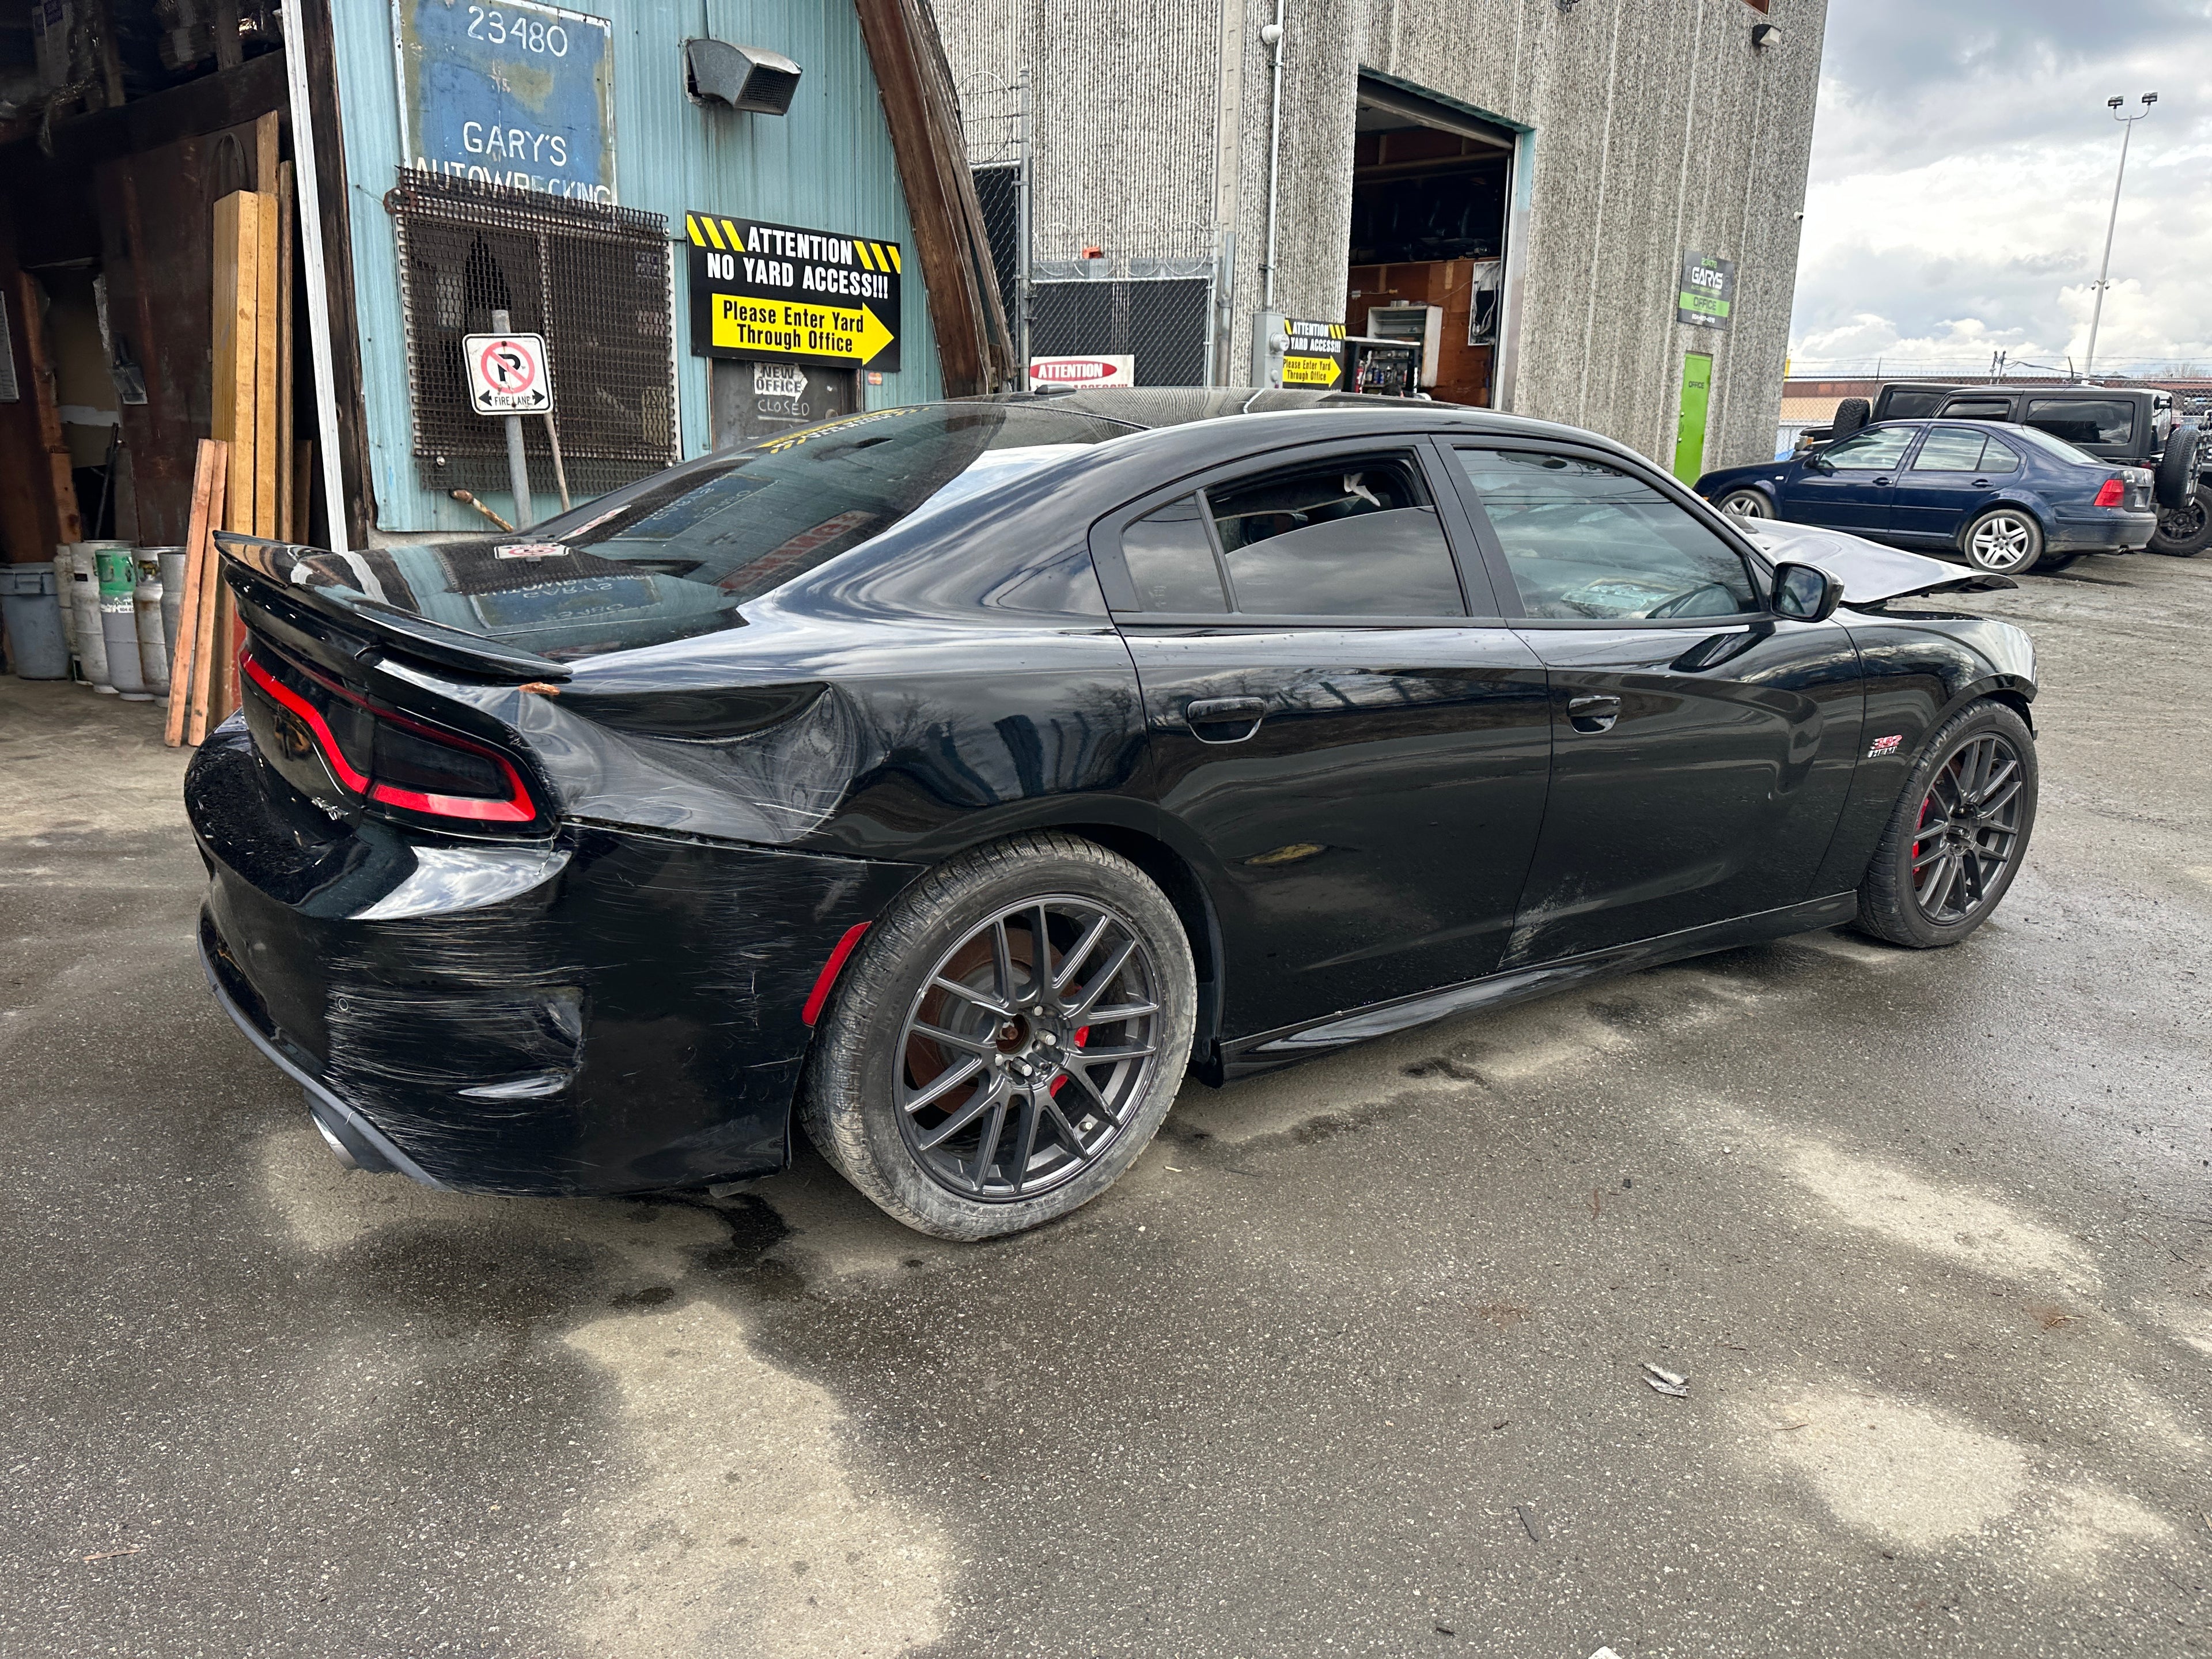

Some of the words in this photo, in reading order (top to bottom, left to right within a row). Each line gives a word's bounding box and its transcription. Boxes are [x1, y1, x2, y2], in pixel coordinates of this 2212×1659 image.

[467, 5, 568, 57] 23480
[463, 121, 567, 167] GARY'S
[747, 226, 853, 265] ATTENTION
[707, 252, 734, 281] NO
[743, 257, 794, 287] YARD
[802, 265, 888, 300] ACCESS!!!
[1691, 266, 1724, 290] GARYS
[1694, 296, 1717, 310] OFFICE
[723, 300, 777, 325] Please
[784, 306, 825, 329] Enter
[832, 312, 864, 334] Yard
[1292, 321, 1329, 337] ATTENTION
[737, 323, 801, 350] Through
[808, 329, 853, 353] Office
[1290, 337, 1308, 350] YARD
[1309, 339, 1341, 353] ACCESS!!!
[1038, 363, 1103, 378] ATTENTION
[1283, 358, 1301, 369] Please
[1302, 360, 1317, 370] Enter
[1319, 361, 1331, 370] Yard
[762, 366, 794, 379] NEW
[1287, 370, 1309, 381] Through
[1310, 371, 1327, 381] Office
[756, 377, 801, 393] OFFICE
[494, 396, 511, 406] FIRE
[758, 399, 809, 416] CLOSED
[1871, 734, 1903, 750] 392
